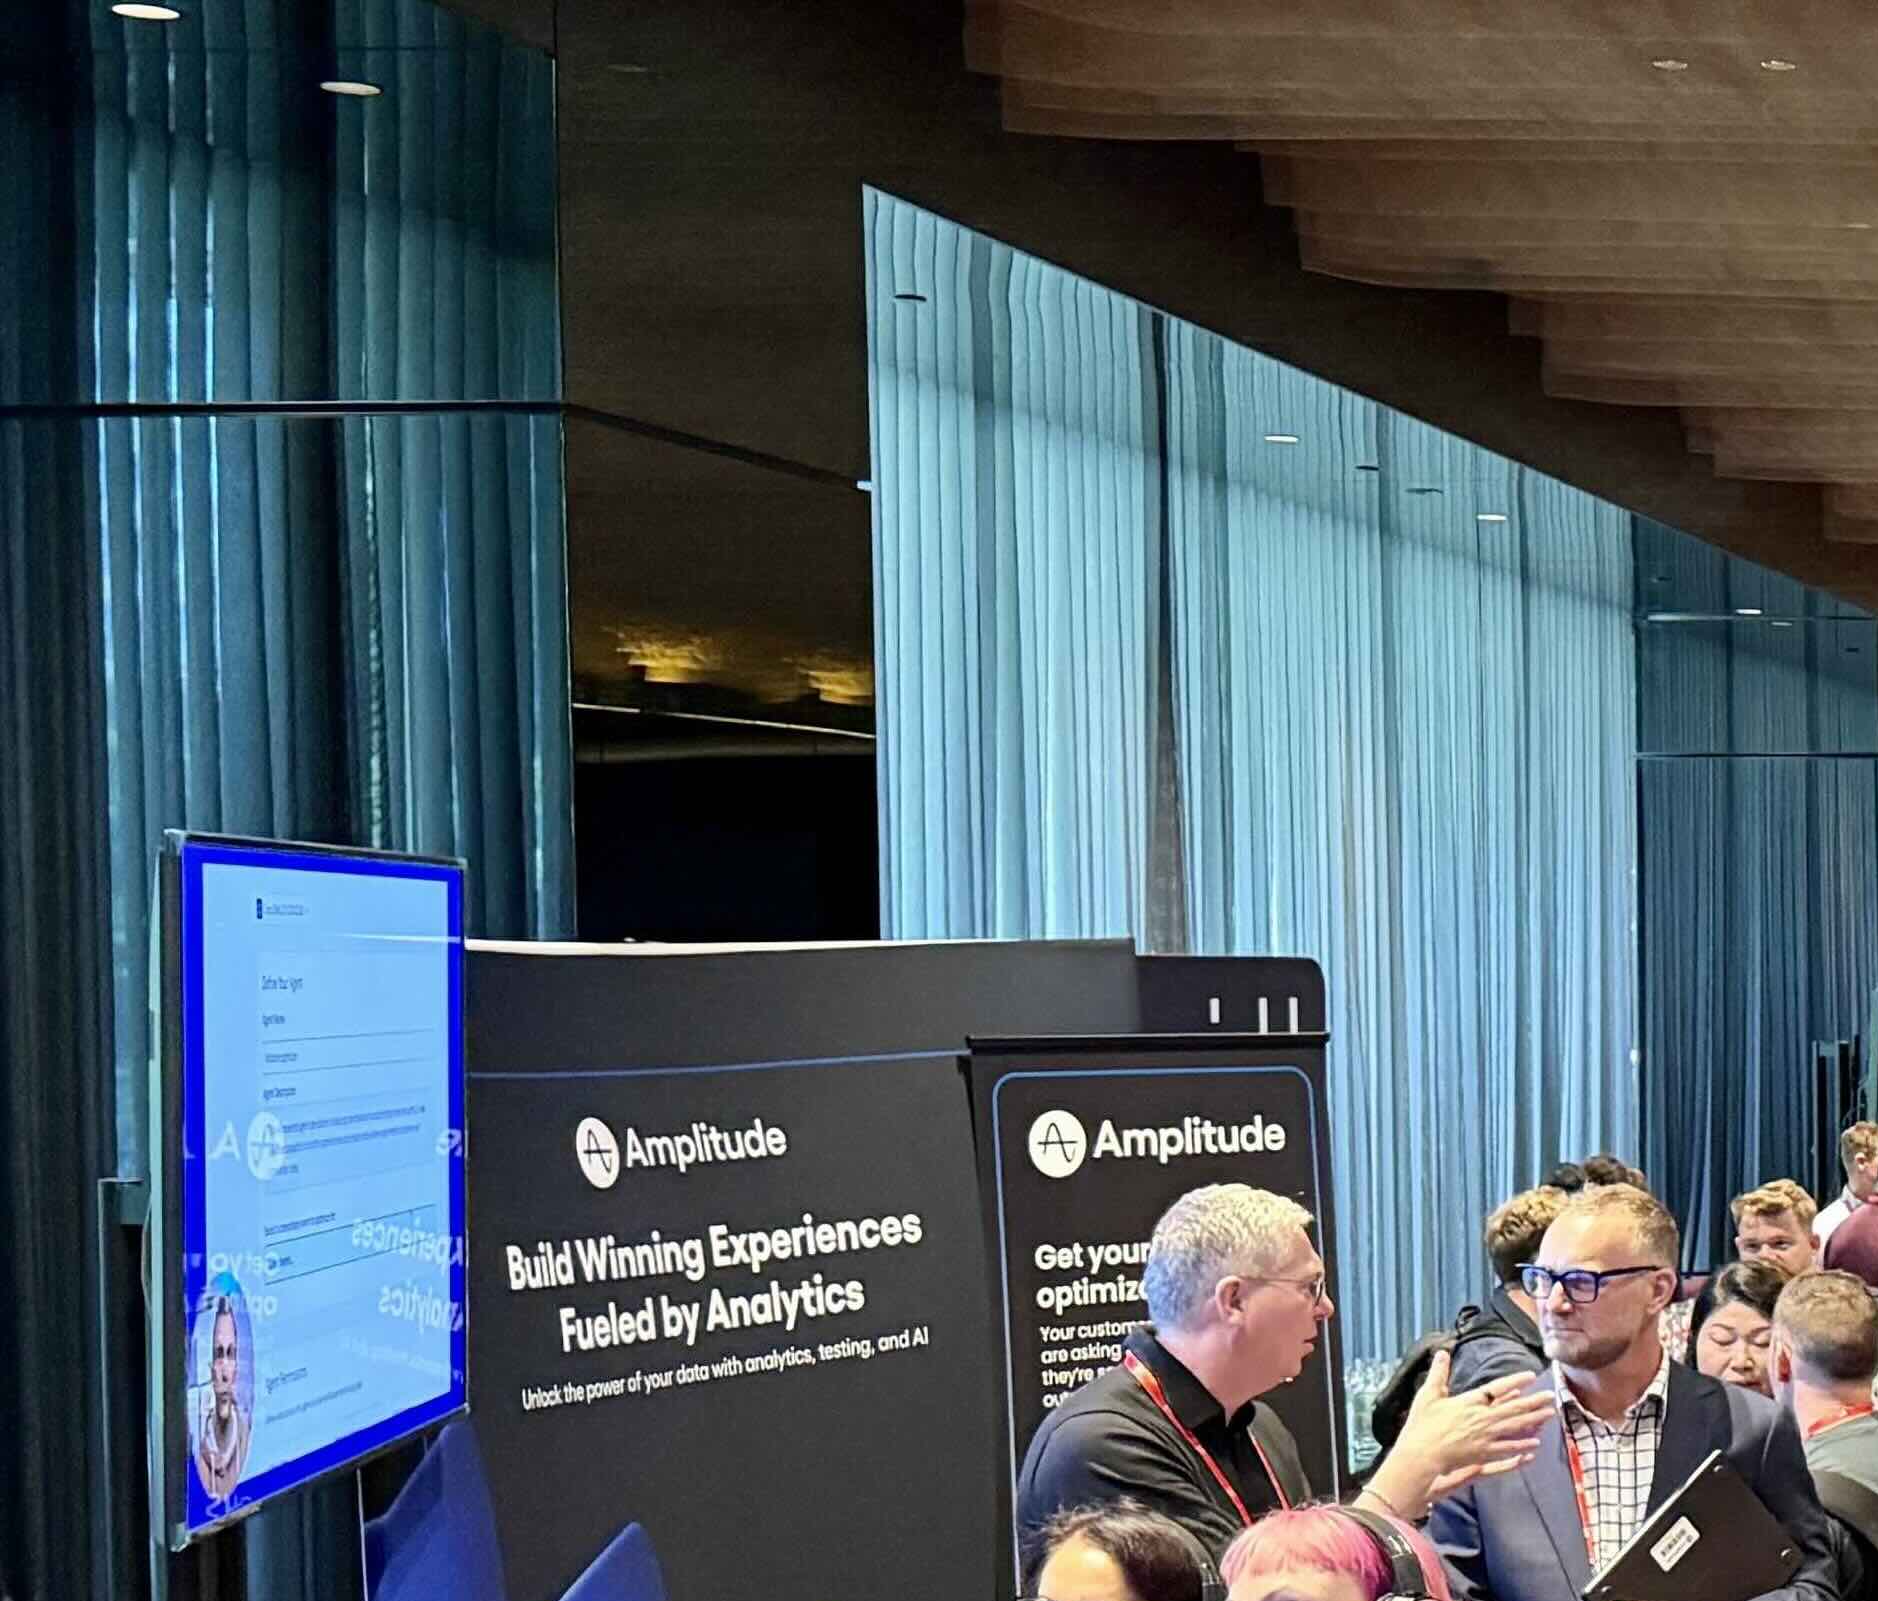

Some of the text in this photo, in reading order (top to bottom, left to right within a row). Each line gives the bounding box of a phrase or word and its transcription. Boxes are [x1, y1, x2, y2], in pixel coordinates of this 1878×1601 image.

[625, 1119, 787, 1172] Amplitude
[1092, 1114, 1286, 1165] Amplitude
[506, 1209, 923, 1294] Build Winning Experiences
[1034, 1241, 1151, 1275] Get your
[559, 1274, 866, 1354] Fueled by Analytics
[1039, 1326, 1075, 1342] Your
[521, 1325, 930, 1412] Unlock the power of your data with analytics, testing, and AI
[1040, 1341, 1122, 1365] are asking
[1041, 1367, 1094, 1388] they're
